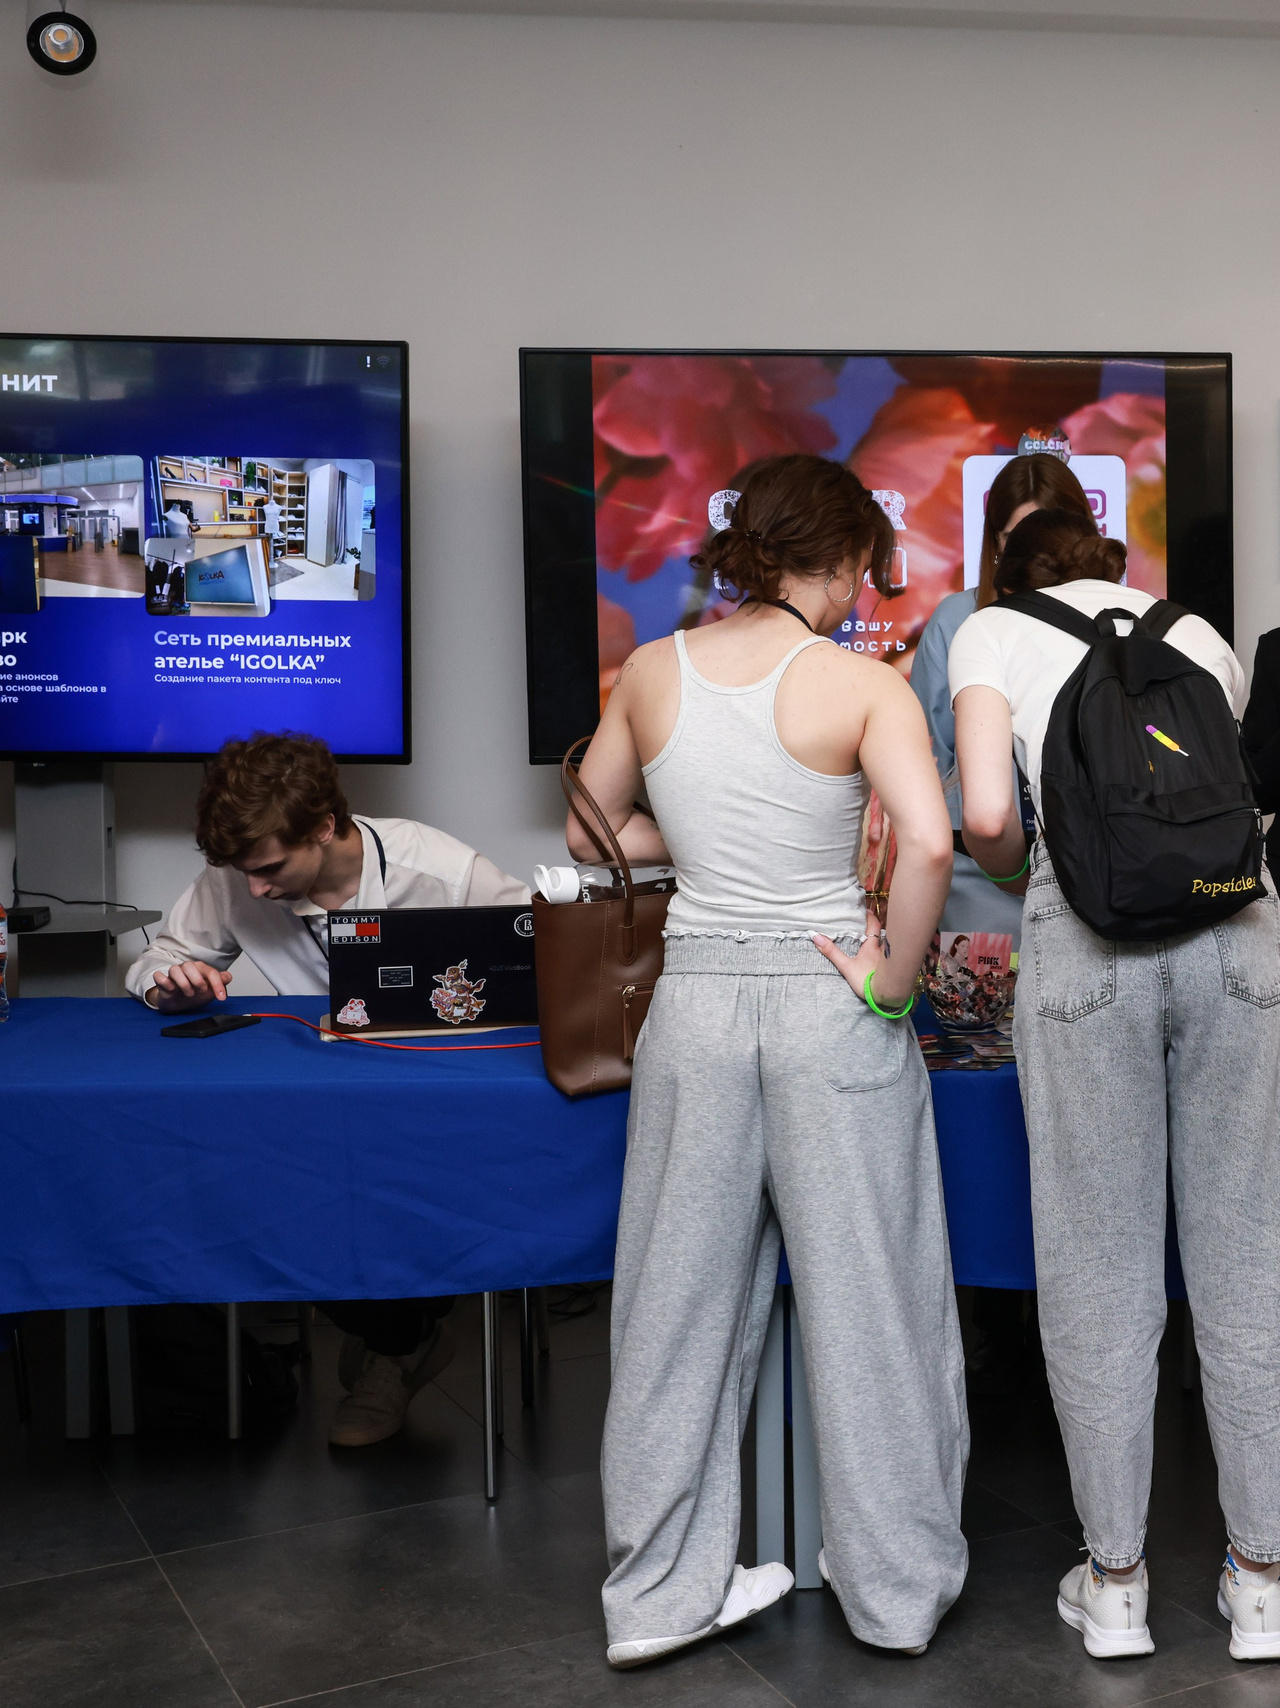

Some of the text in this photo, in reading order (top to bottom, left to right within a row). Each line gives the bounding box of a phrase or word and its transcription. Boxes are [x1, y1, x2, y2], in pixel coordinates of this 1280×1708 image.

[2, 374, 58, 392] НИТ
[841, 620, 893, 632] вашу
[0, 630, 27, 647] рк
[154, 631, 351, 649] Сеть премиальных
[154, 655, 224, 669] ателье
[154, 674, 341, 686] Создание пакета контента под ключ
[5, 685, 43, 693] основе
[45, 684, 98, 693] шаблонов
[0, 695, 19, 703] йте
